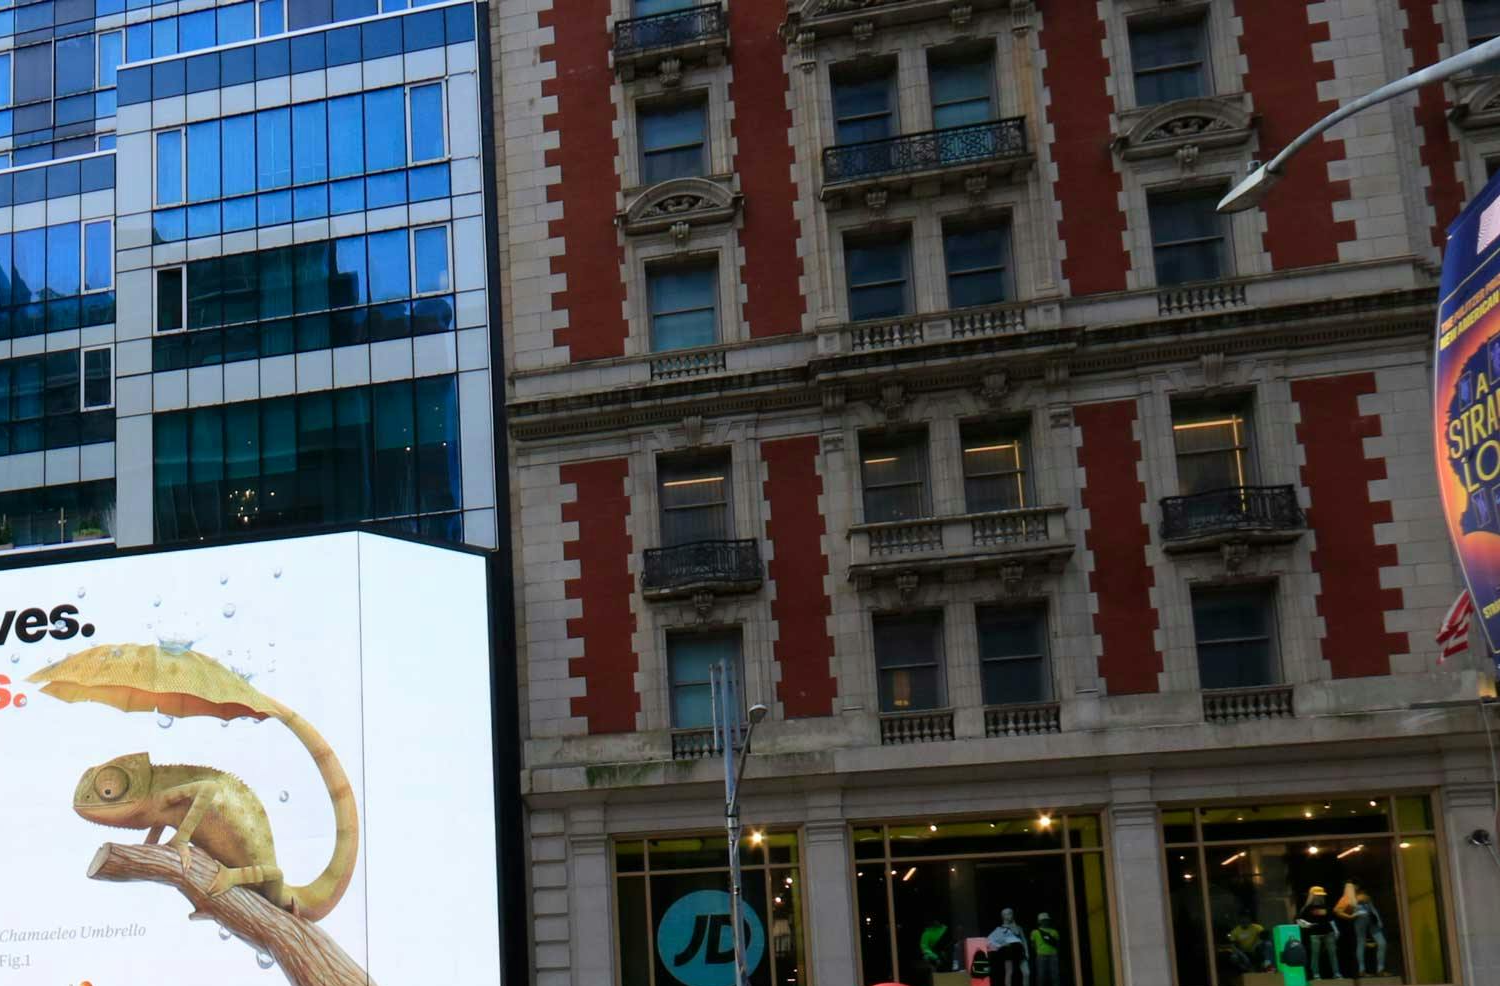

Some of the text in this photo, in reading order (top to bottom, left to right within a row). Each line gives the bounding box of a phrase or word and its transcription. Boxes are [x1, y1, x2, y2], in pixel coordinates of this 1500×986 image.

[1476, 372, 1488, 400] A
[0, 923, 147, 944] Chamaeleo Umbrello
[674, 914, 752, 967] JD
